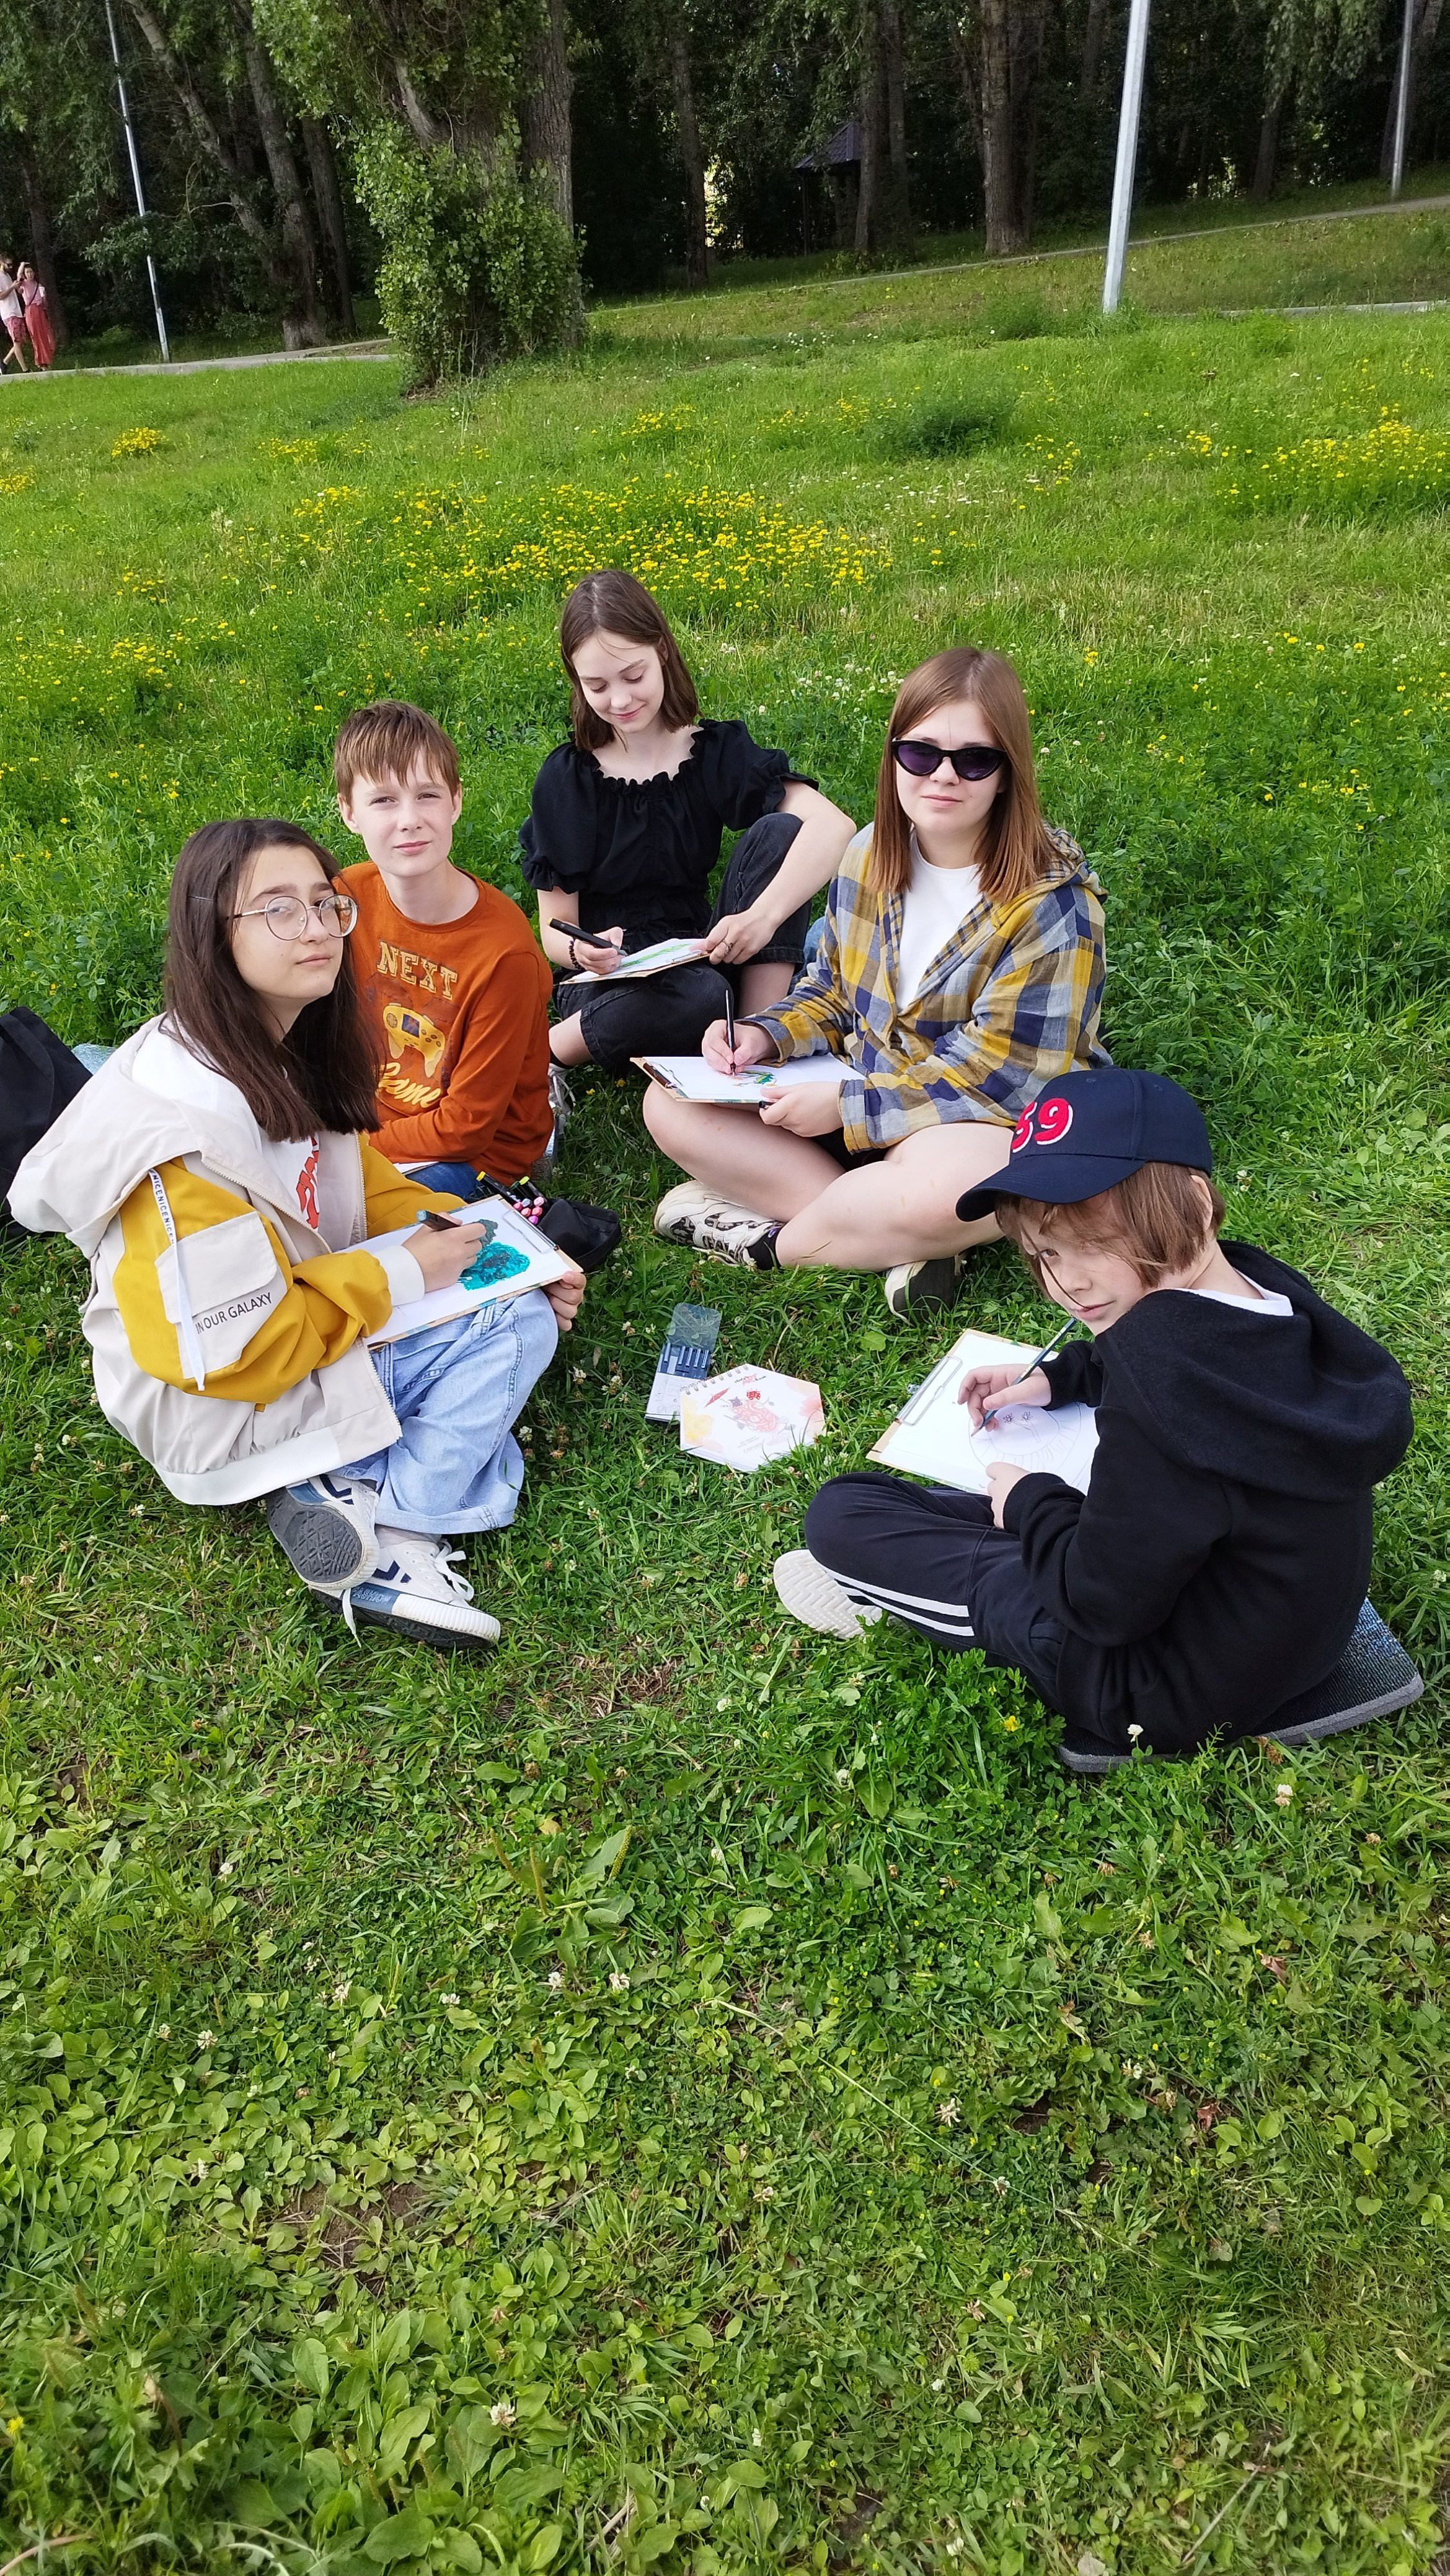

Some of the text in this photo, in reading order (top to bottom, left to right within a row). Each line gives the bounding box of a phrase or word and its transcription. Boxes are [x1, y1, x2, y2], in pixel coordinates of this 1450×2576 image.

[377, 941, 458, 999] NEXT
[195, 1292, 272, 1334] IN OUR GALAXY
